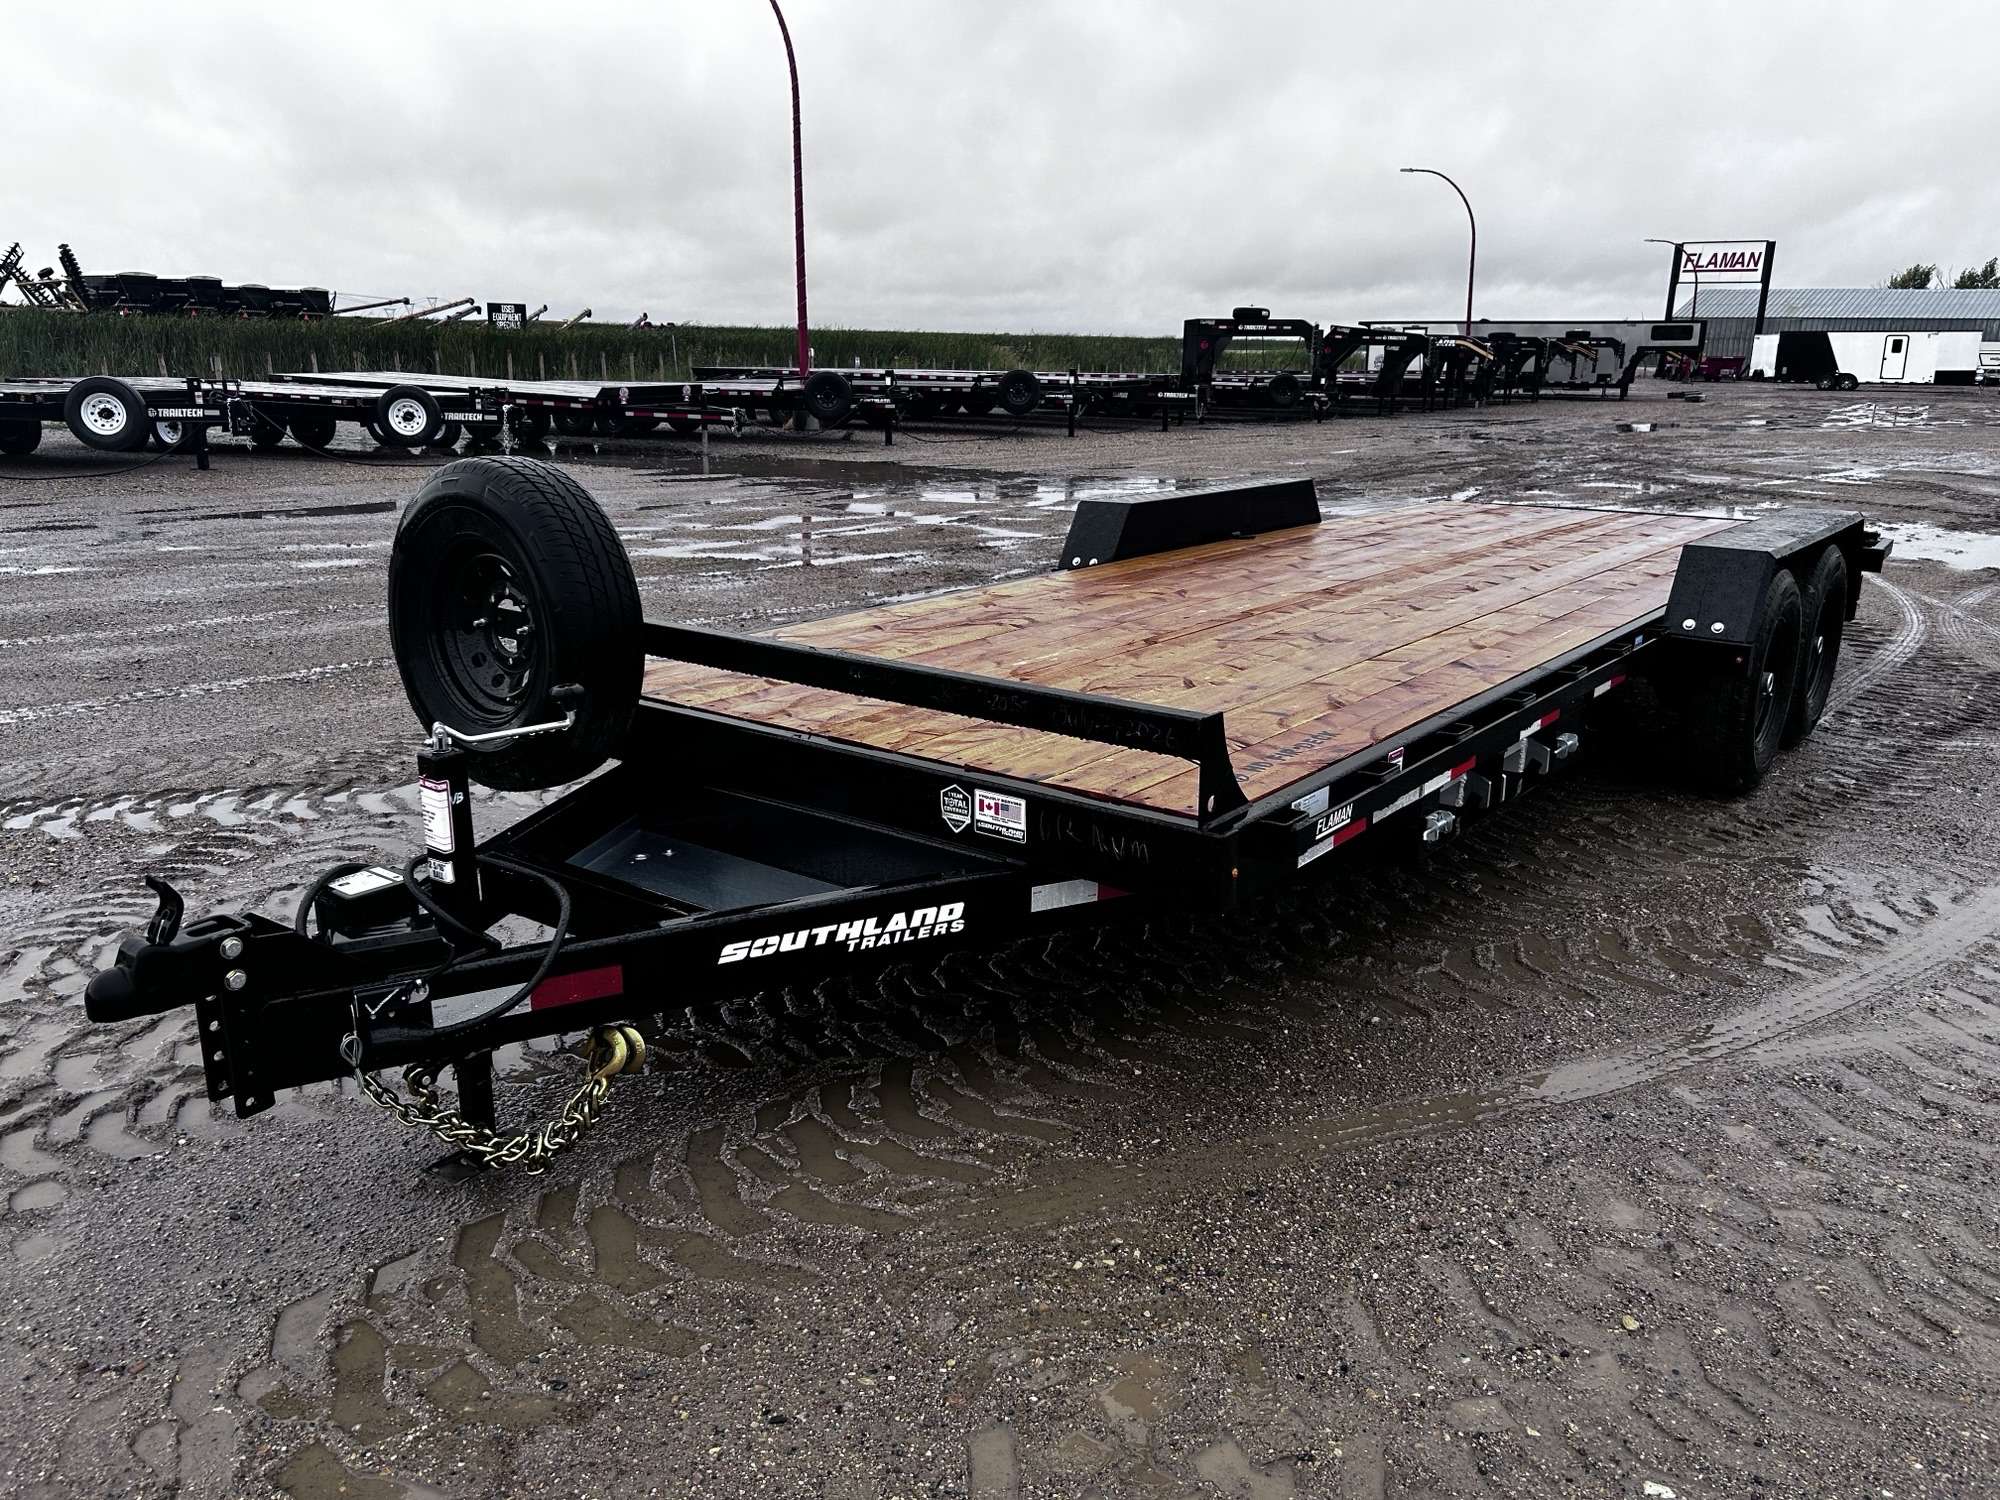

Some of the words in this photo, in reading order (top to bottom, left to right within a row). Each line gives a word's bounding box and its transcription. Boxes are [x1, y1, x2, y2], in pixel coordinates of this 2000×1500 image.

[1683, 252, 1762, 269] FLAMAN
[501, 305, 515, 313] USED
[492, 312, 522, 321] EQUIPMENT
[157, 408, 204, 418] TRAILTECH
[444, 412, 484, 421] TRAILTECH
[943, 796, 968, 809] TOTAL
[943, 805, 968, 815] COVERAGE
[1315, 802, 1354, 835] FLAMAN
[717, 901, 966, 966] SOUTHLAND
[846, 918, 966, 953] TRAILERS
